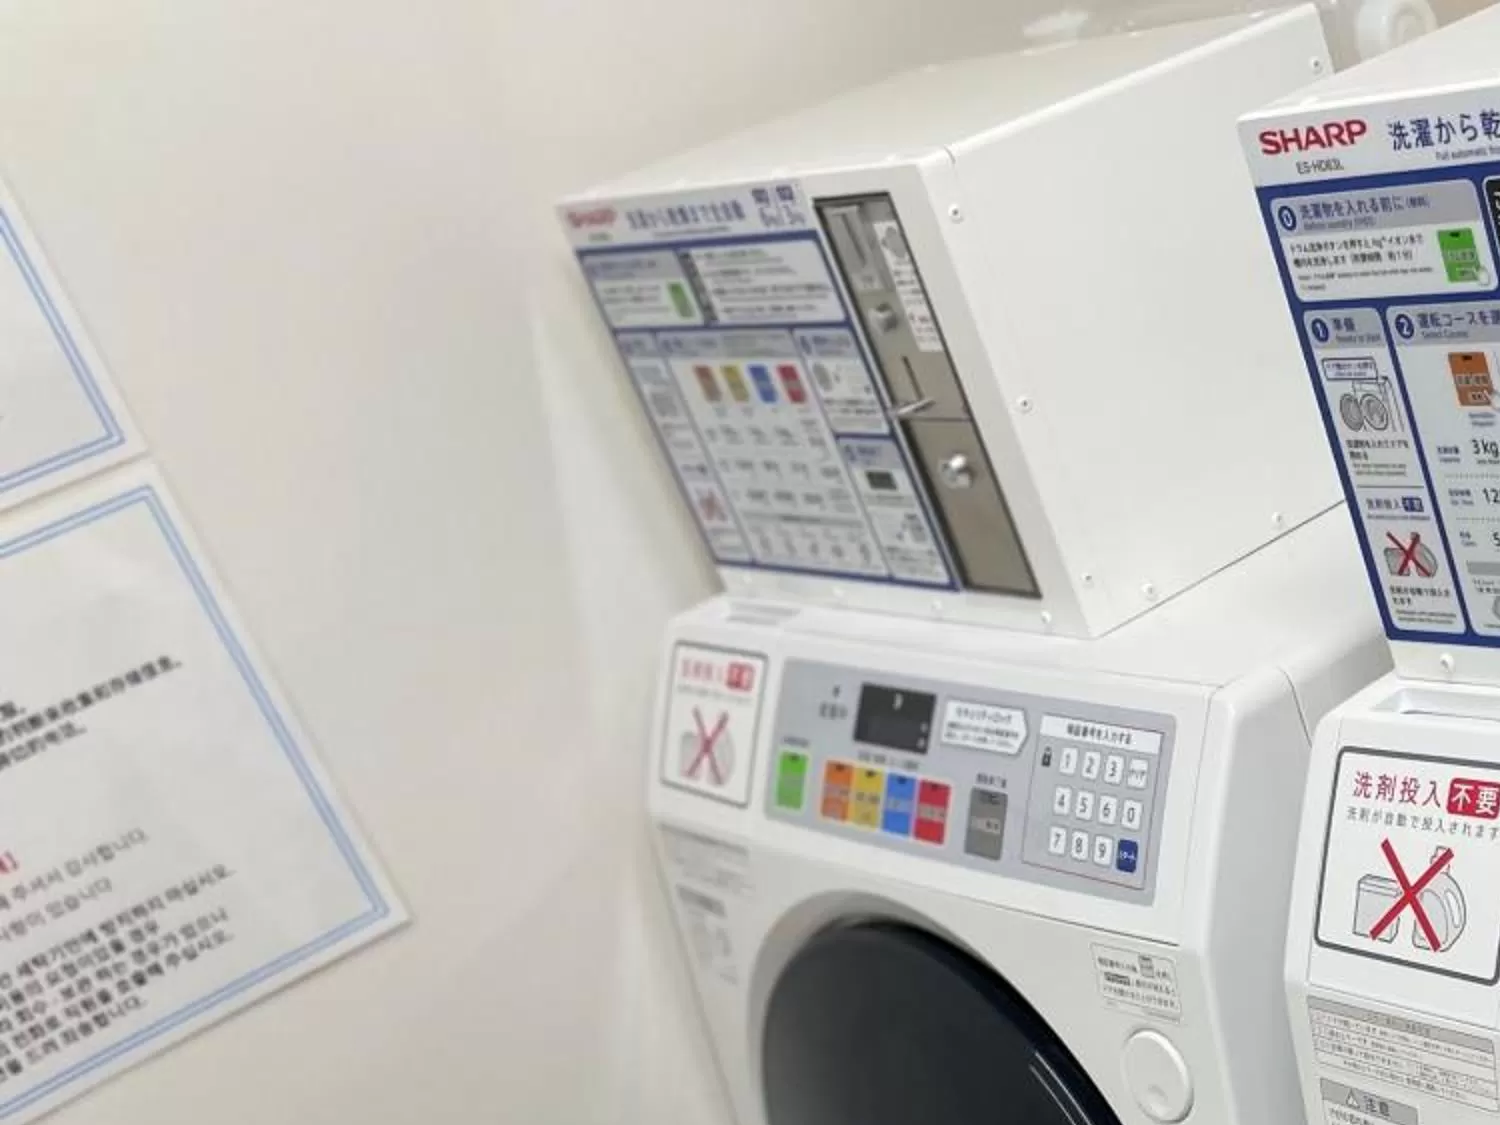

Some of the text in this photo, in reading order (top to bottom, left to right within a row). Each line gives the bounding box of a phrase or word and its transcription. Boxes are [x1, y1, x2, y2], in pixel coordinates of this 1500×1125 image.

[1258, 118, 1368, 156] SHARP
[1352, 771, 1500, 816] 洗剤投入 不要
[1346, 806, 1500, 841] 洗剤が自動で投入されます
